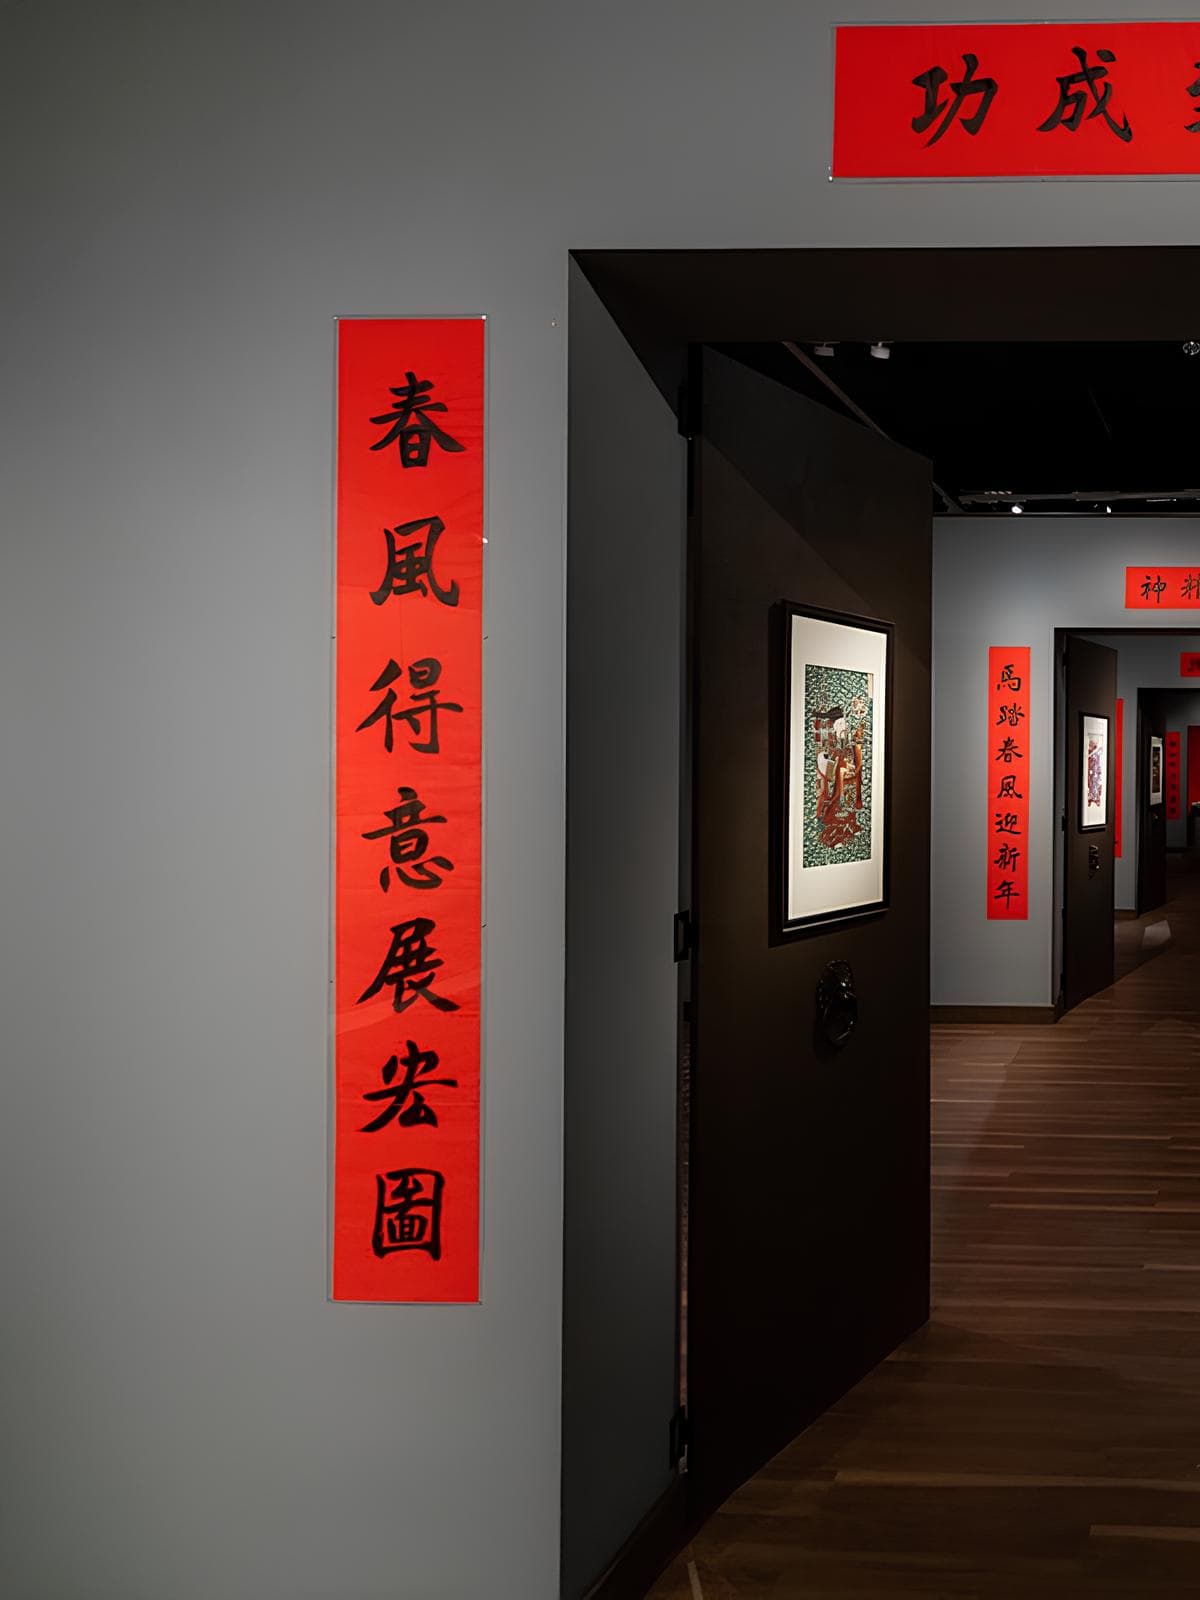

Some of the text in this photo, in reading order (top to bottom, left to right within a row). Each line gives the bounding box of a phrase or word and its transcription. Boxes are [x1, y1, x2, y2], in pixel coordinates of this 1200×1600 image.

[355, 371, 466, 1262] 春風得意展宏圖
[993, 663, 1025, 908] 馬踏春風迎新年
